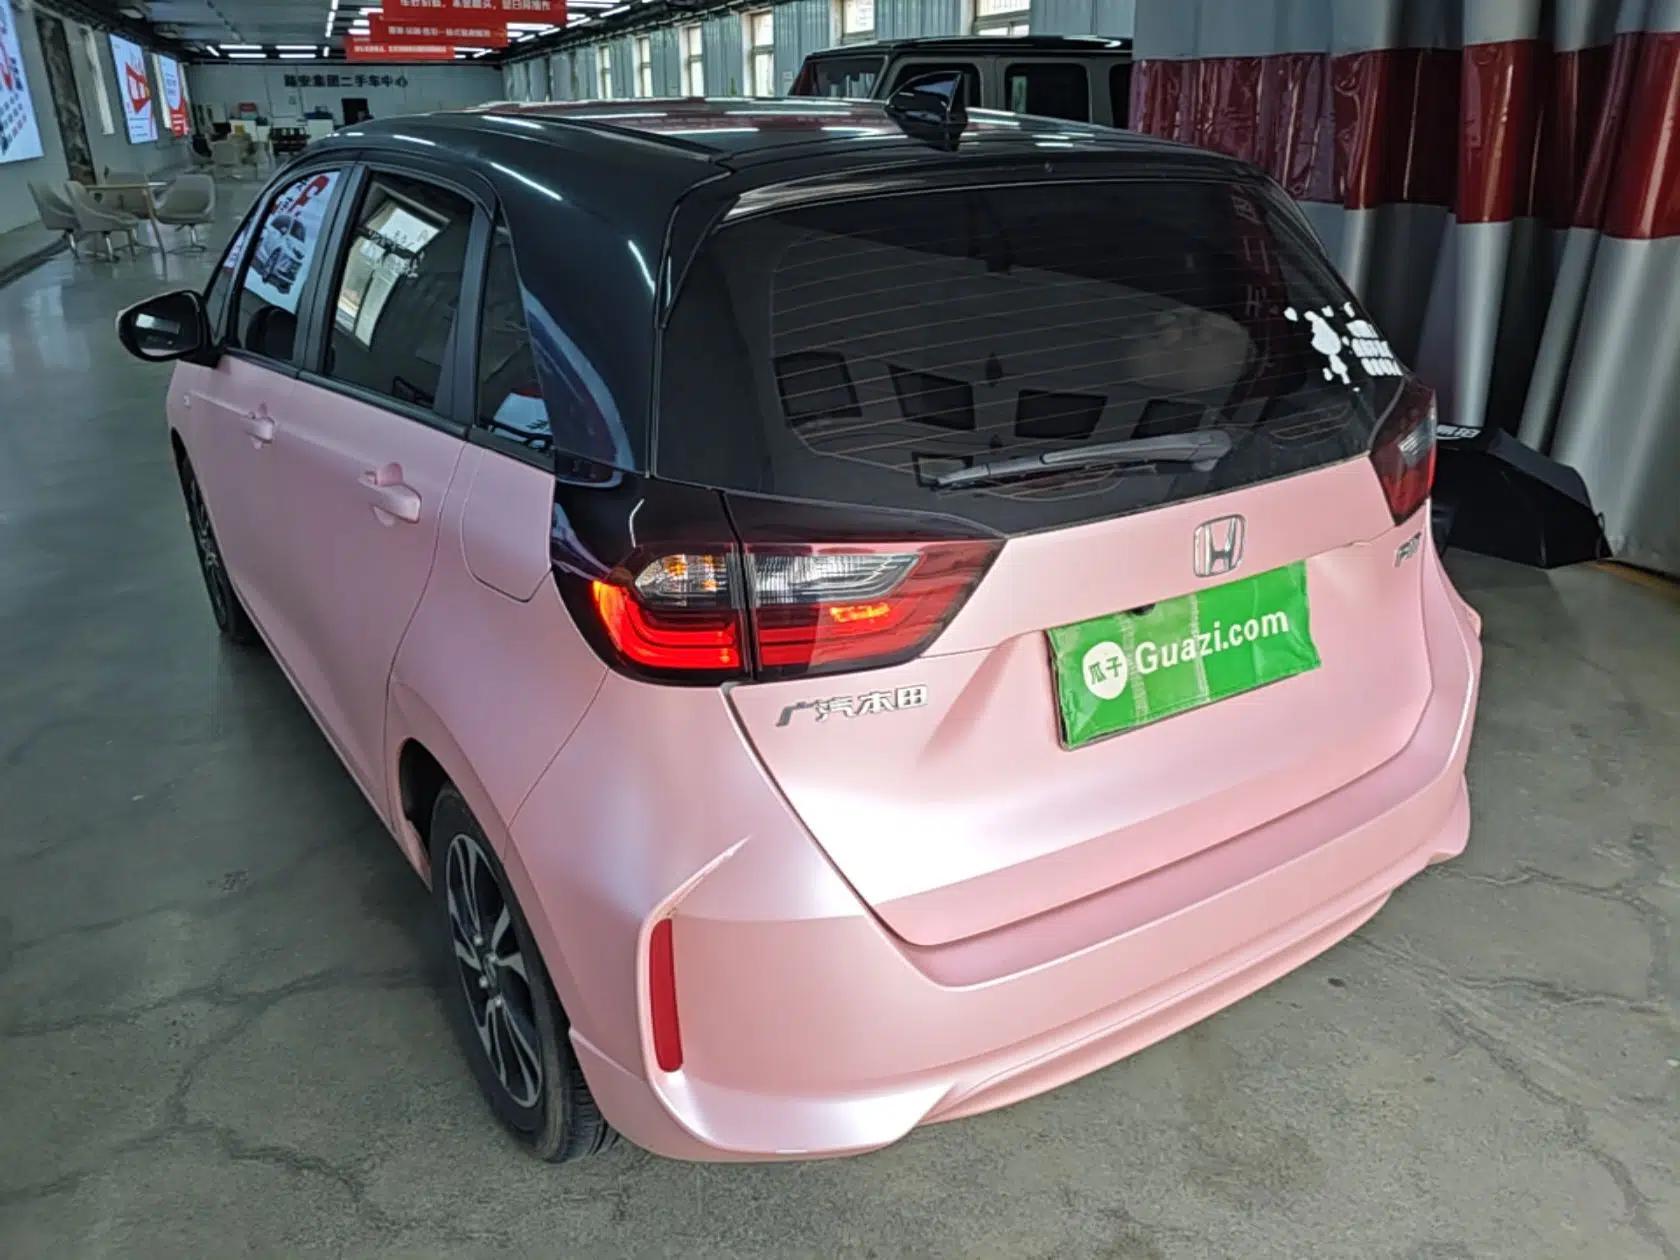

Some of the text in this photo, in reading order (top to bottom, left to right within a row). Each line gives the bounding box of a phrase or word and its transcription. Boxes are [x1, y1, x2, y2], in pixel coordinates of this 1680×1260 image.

[1134, 611, 1289, 675] Guazi.com
[1088, 655, 1123, 685] 瓜子
[776, 684, 928, 728] 广汽本田
